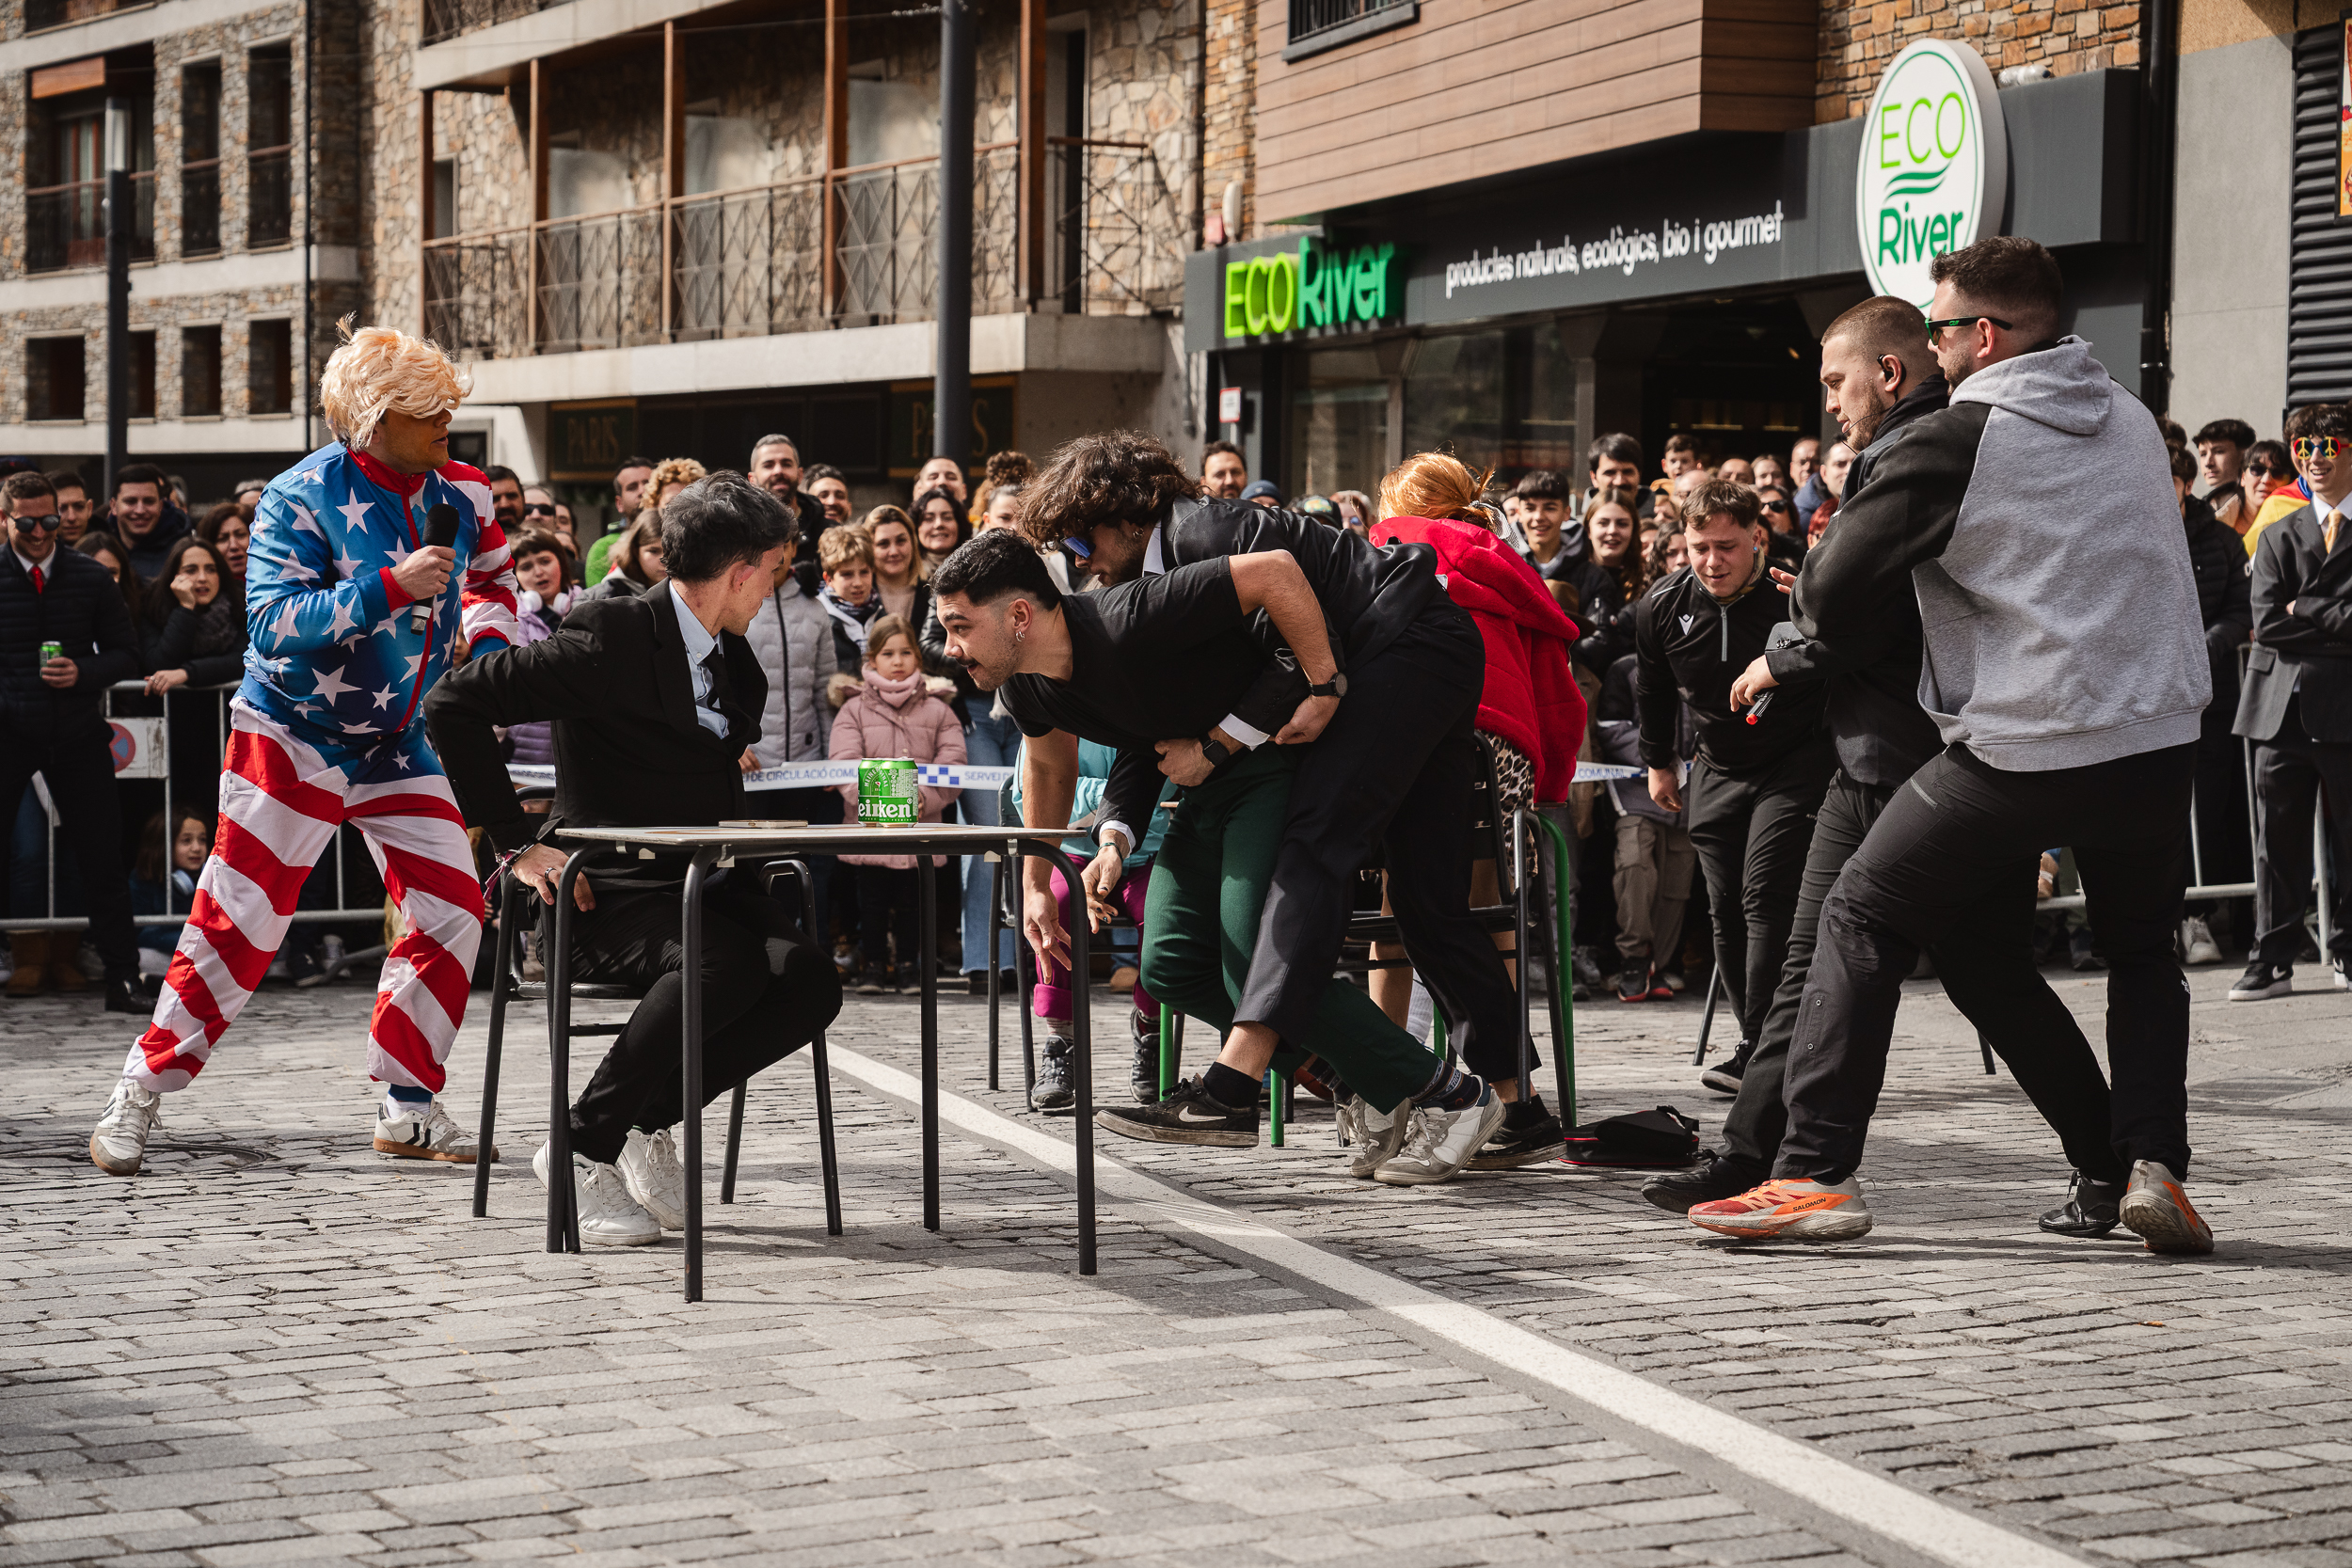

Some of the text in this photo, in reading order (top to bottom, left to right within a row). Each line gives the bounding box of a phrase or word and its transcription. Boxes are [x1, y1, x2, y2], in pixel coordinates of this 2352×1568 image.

[1880, 91, 1965, 169] ECO
[1445, 245, 1515, 299] productes
[1581, 224, 1660, 277] ecològics,
[1662, 217, 1691, 259] bio
[1693, 217, 1701, 254] i
[1703, 198, 1785, 265] gourmet
[1878, 200, 1964, 267] River
[566, 414, 620, 466] PARIS
[766, 767, 828, 782] CIRCULACIÓ
[829, 768, 858, 779] COMU
[964, 770, 1002, 782] SERVEI
[1792, 1196, 1827, 1212] SALOMON
